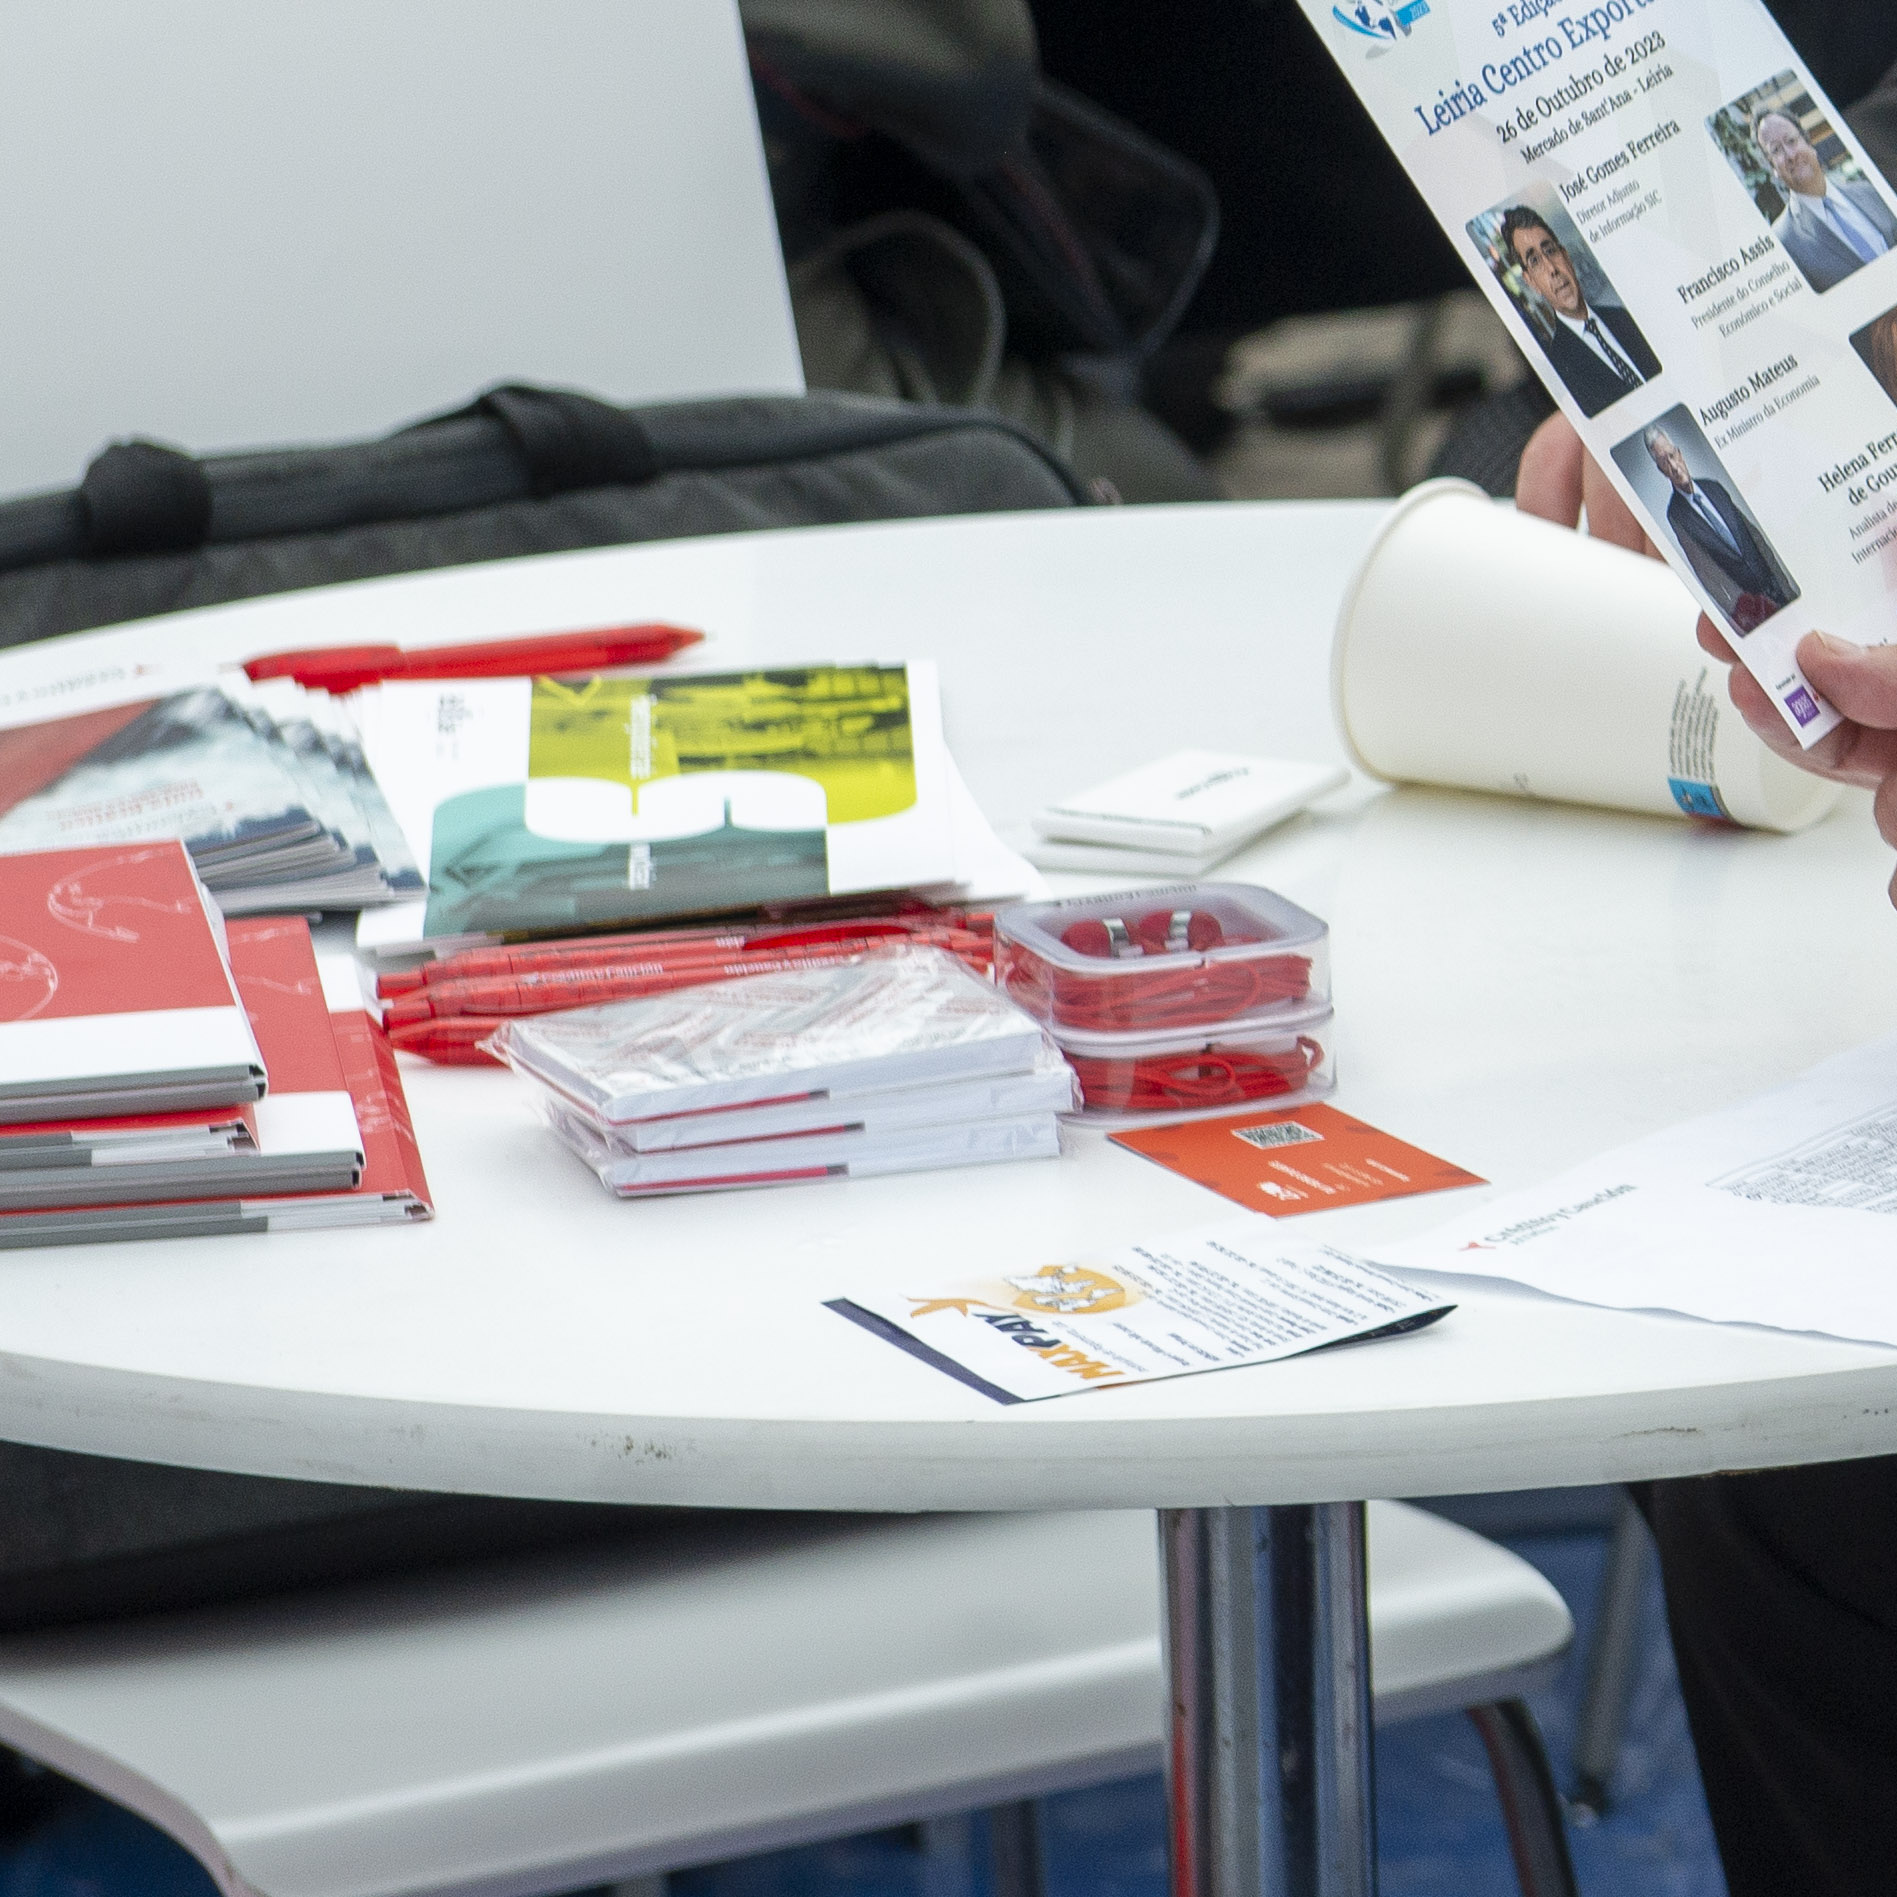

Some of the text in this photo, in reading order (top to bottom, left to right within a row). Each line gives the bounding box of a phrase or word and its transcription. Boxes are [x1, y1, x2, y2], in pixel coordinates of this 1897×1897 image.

[1414, 80, 1488, 136] Leiria
[1482, 36, 1563, 96] Centro
[1496, 30, 1666, 144] 26 de Outubro de 2023
[1520, 127, 1568, 165] Mercado
[1568, 118, 1584, 135] de
[1637, 64, 1673, 93] Leiria
[1559, 119, 1681, 203] José Gomes Ferreira
[1576, 180, 1640, 225] Diretor Adjunto
[1589, 229, 1600, 243] de
[1599, 204, 1647, 240] Informação
[1677, 235, 1775, 304] Francisco Assis
[1691, 260, 1790, 330] Presidente do Conselho
[1768, 297, 1776, 307] e
[1773, 276, 1803, 302] Social
[1700, 354, 1798, 426] Augusto Mateus
[1714, 375, 1820, 450] Ex Ministro da Economia
[1817, 453, 1870, 494] Helena
[1848, 486, 1869, 506] de
[1849, 499, 1897, 541] Analista de
[972, 1313, 1126, 1380] MAXPAY
